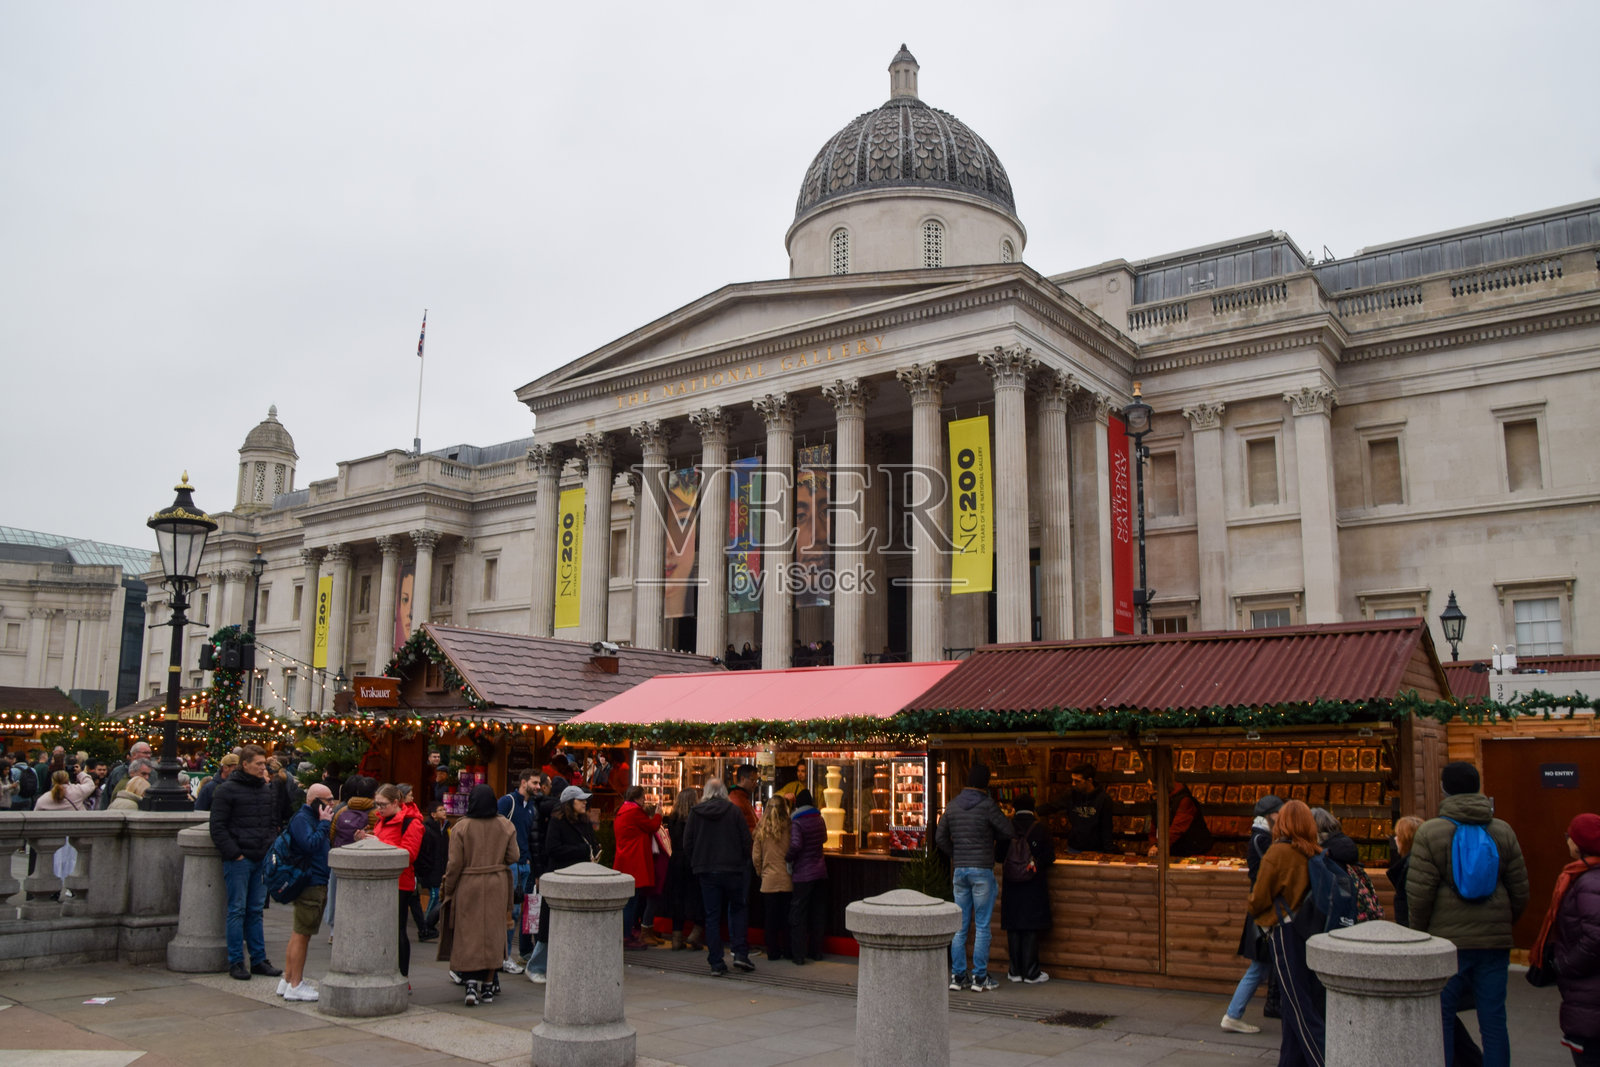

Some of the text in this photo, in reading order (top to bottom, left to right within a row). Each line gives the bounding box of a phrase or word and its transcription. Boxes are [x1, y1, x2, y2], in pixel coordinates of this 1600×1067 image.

[616, 335, 886, 410] THE NATIONAL GALLERY
[957, 448, 978, 556] NG200
[1114, 448, 1123, 540] NATIONAL
[1120, 451, 1129, 544] GALLERY
[561, 512, 574, 597] NG200
[317, 592, 326, 647] NG200
[181, 705, 208, 721] GRILL
[360, 686, 391, 699] Krakauer
